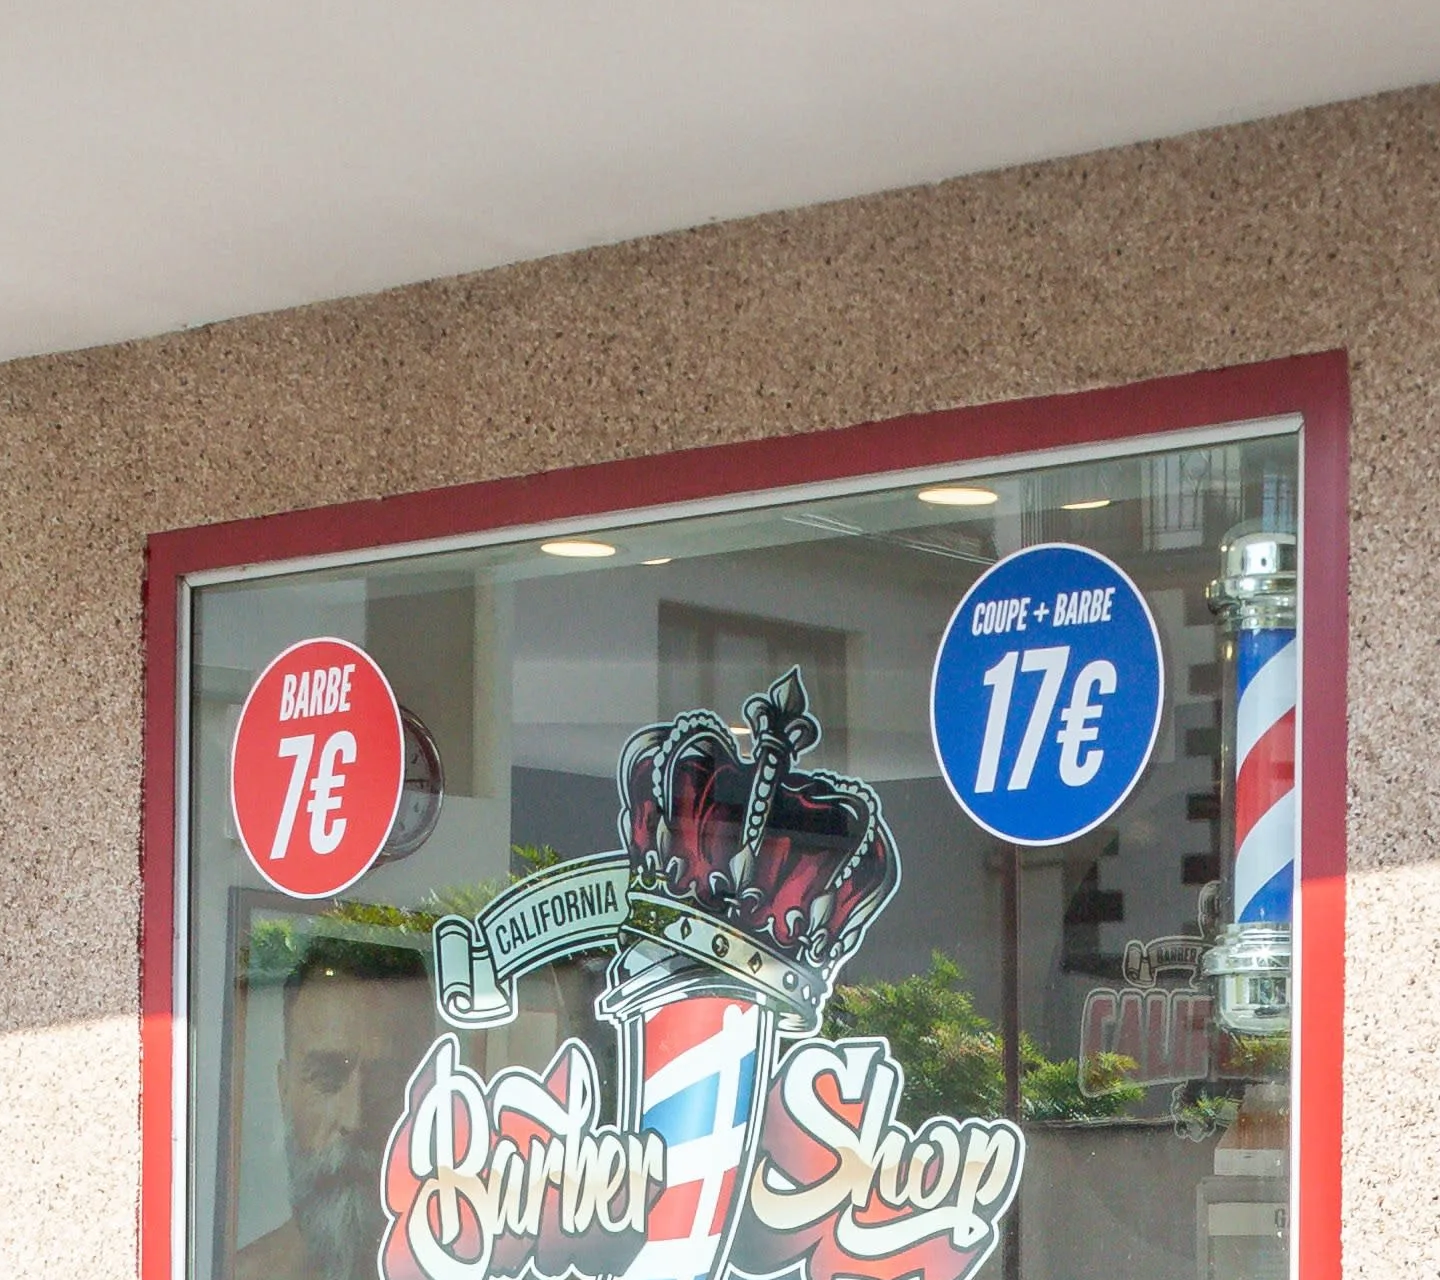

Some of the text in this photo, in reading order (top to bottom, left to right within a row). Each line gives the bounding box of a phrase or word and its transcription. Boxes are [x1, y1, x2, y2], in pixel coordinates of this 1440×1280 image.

[971, 587, 1117, 637] COUPE + BARBE
[279, 663, 356, 721] BARBE
[973, 645, 1118, 795] 17€
[269, 730, 358, 861] 7€
[494, 881, 621, 957] CALIFORNIA
[751, 1043, 1017, 1257] Shop
